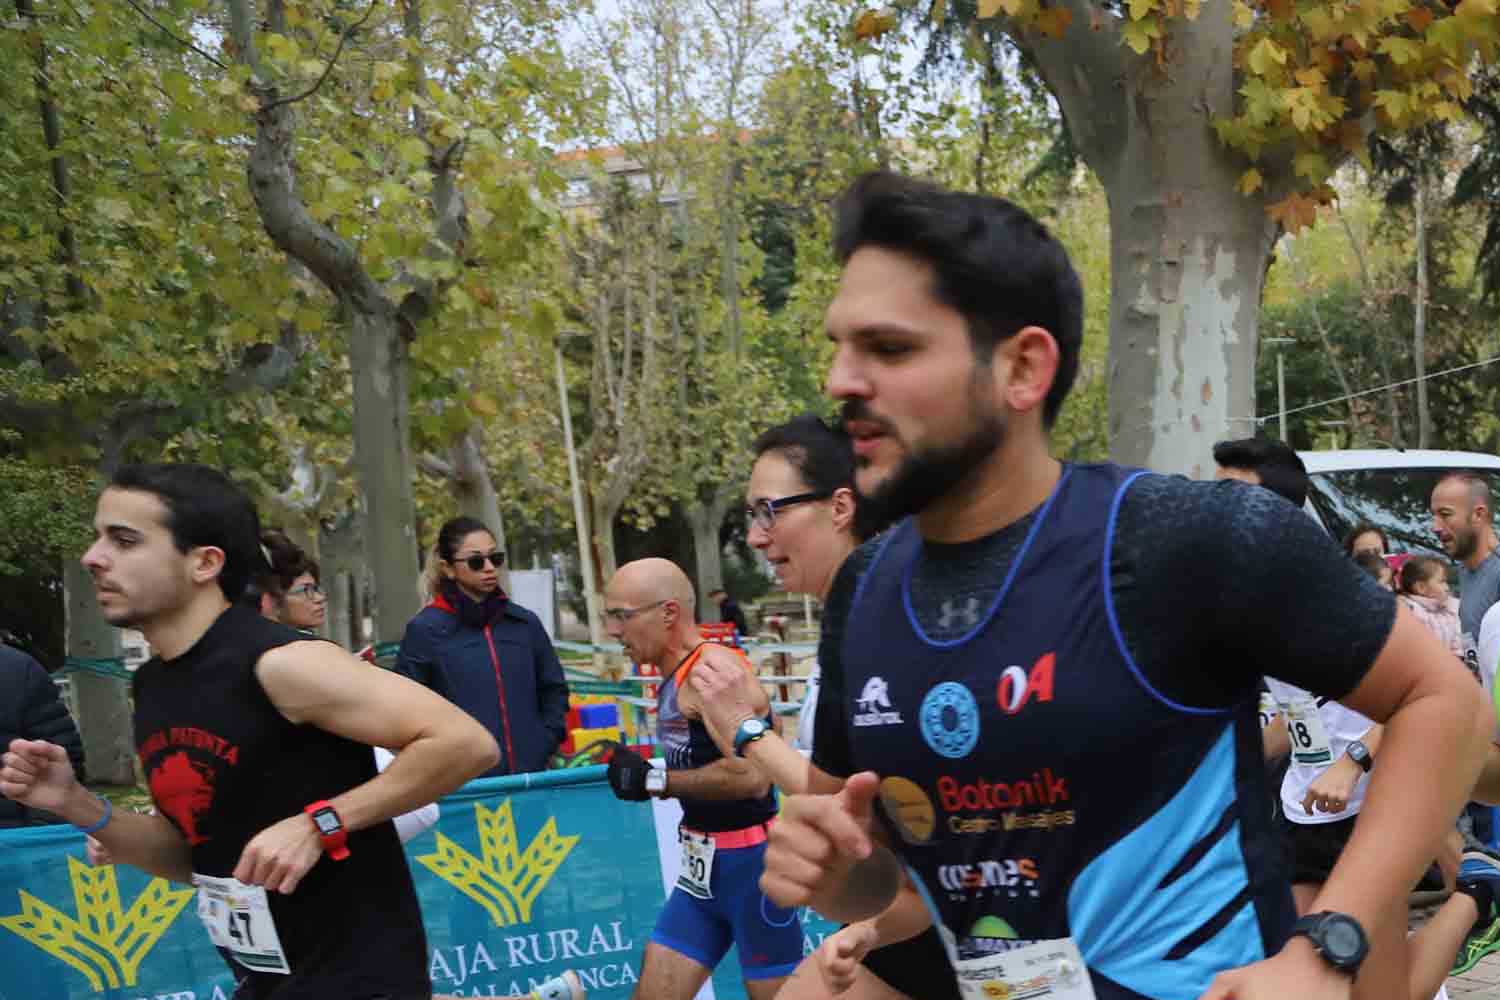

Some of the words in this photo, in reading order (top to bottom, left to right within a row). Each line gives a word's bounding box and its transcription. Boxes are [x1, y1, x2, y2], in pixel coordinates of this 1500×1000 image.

[229, 911, 255, 947] 47
[429, 940, 497, 985] AJA
[504, 921, 633, 967] RURAL
